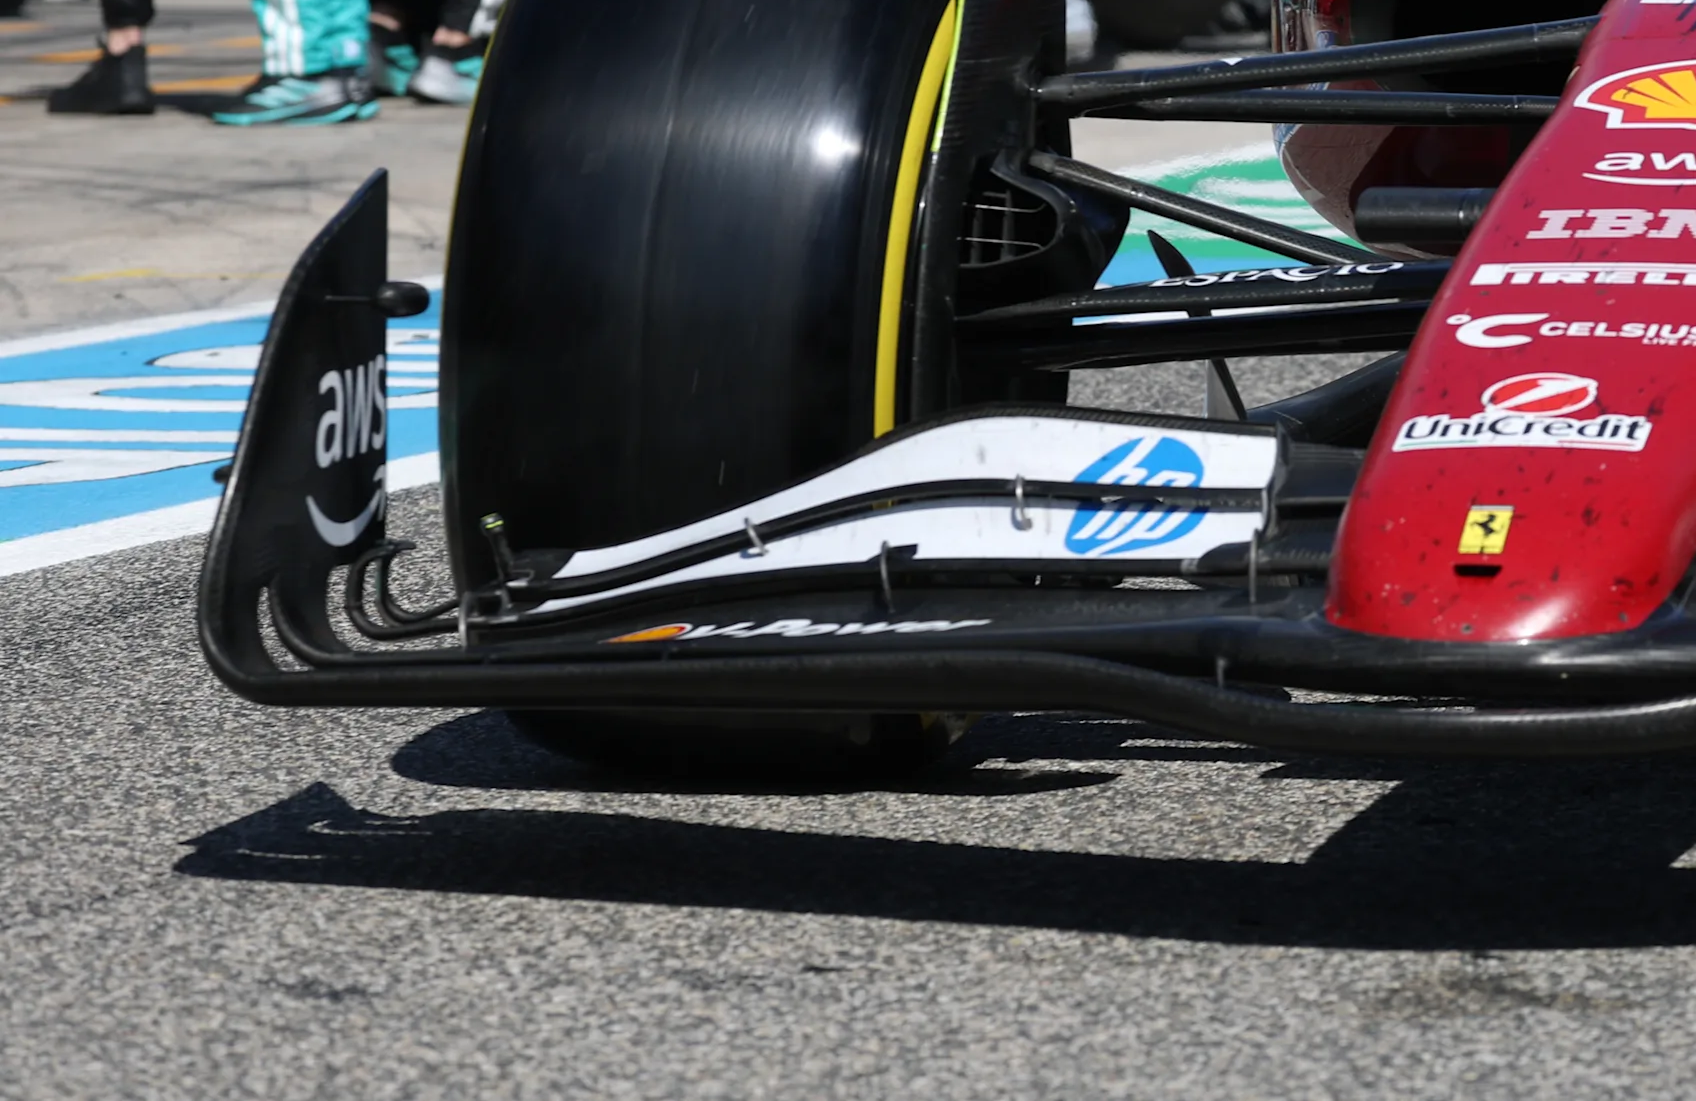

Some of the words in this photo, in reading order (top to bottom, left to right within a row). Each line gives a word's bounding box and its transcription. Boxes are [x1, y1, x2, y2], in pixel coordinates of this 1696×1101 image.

[1150, 261, 1404, 288] ESPACIO
[316, 354, 386, 469] aws
[1404, 413, 1649, 442] UniCredit
[1073, 437, 1198, 555] hp
